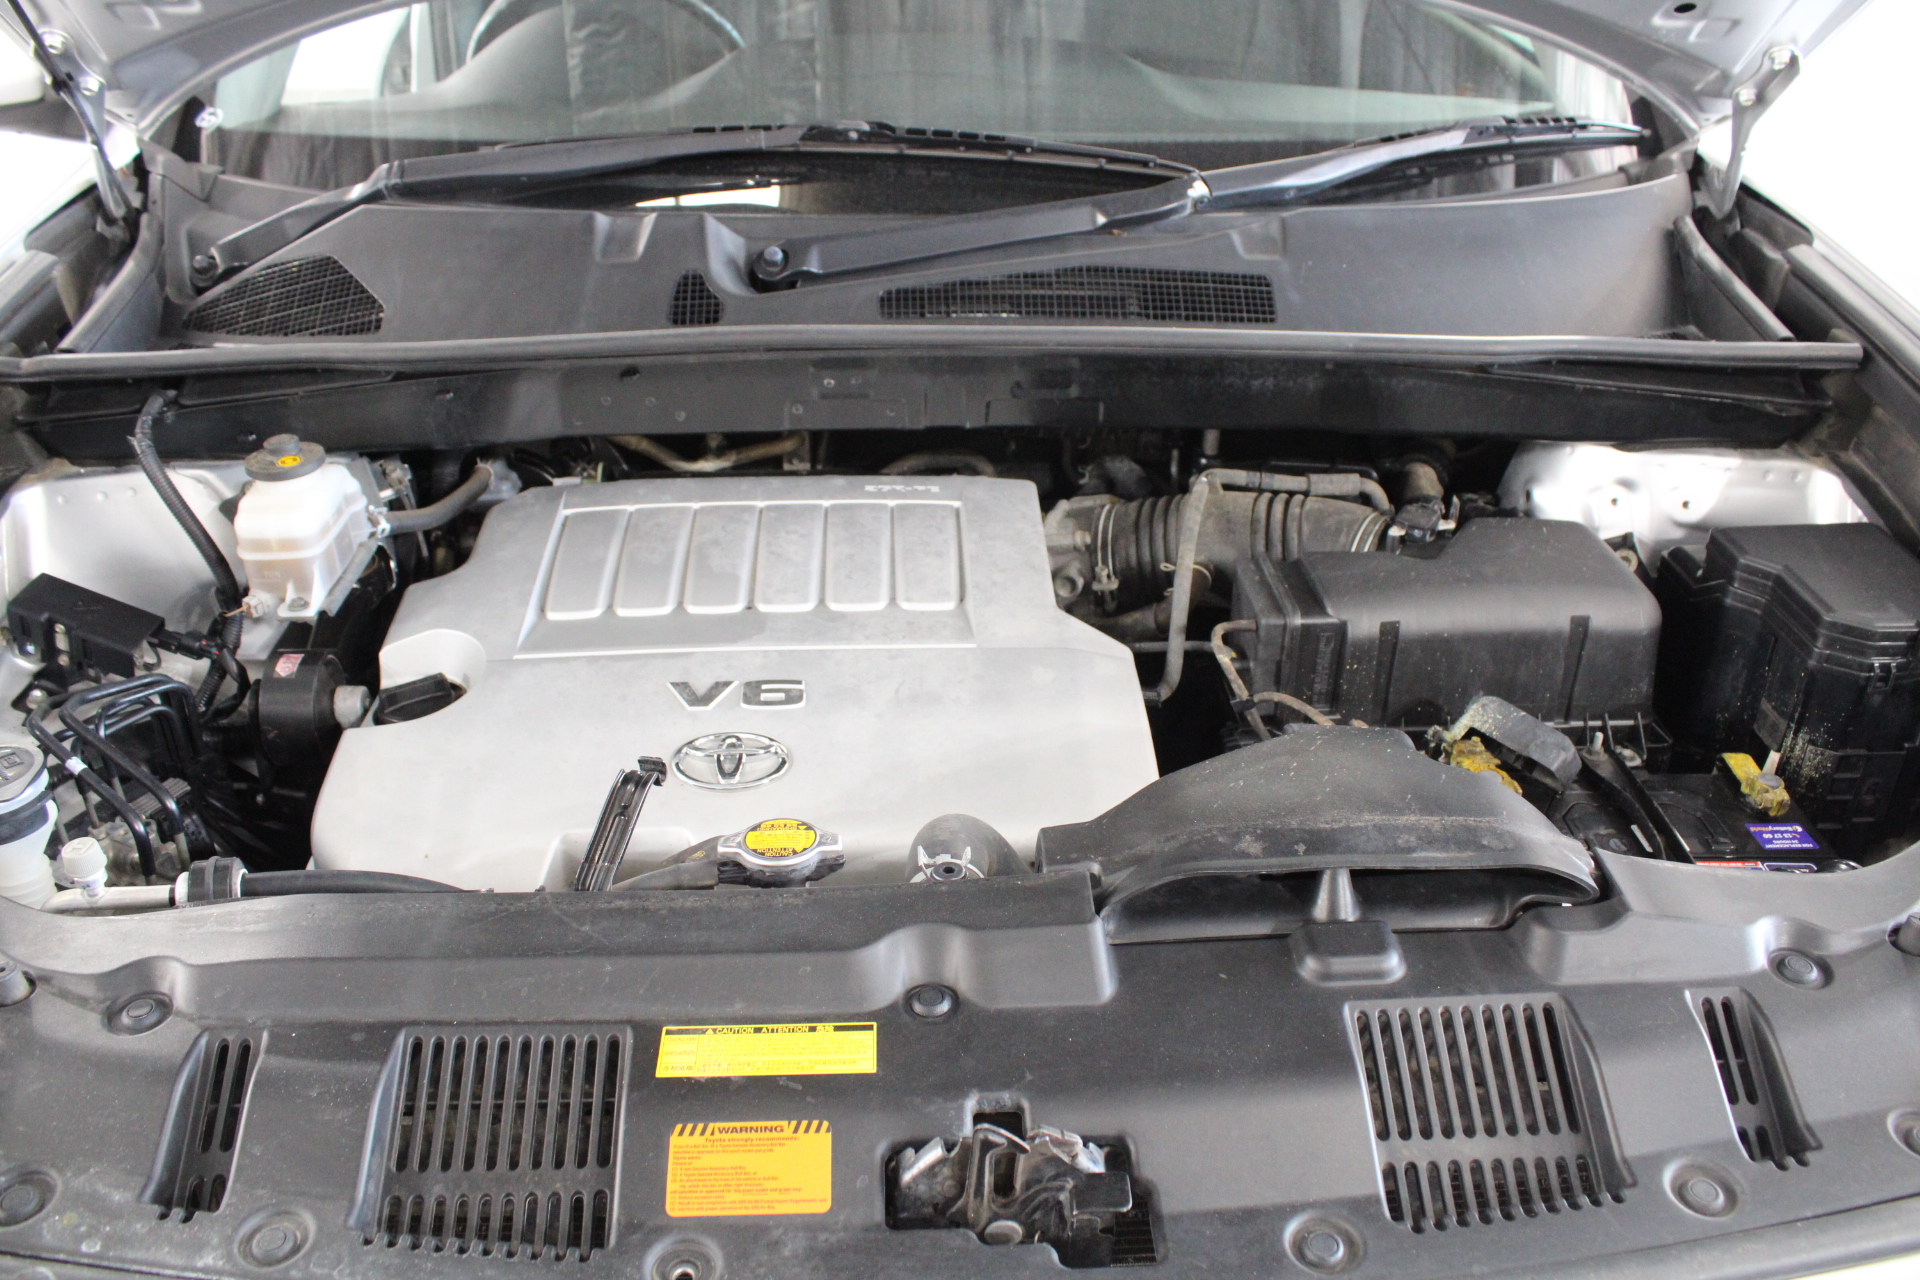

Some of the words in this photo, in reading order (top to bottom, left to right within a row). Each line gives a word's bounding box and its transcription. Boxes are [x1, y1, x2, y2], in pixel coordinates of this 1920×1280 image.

[666, 679, 806, 711] V6
[65, 838, 94, 854] H
[718, 1125, 784, 1134] WARNING
